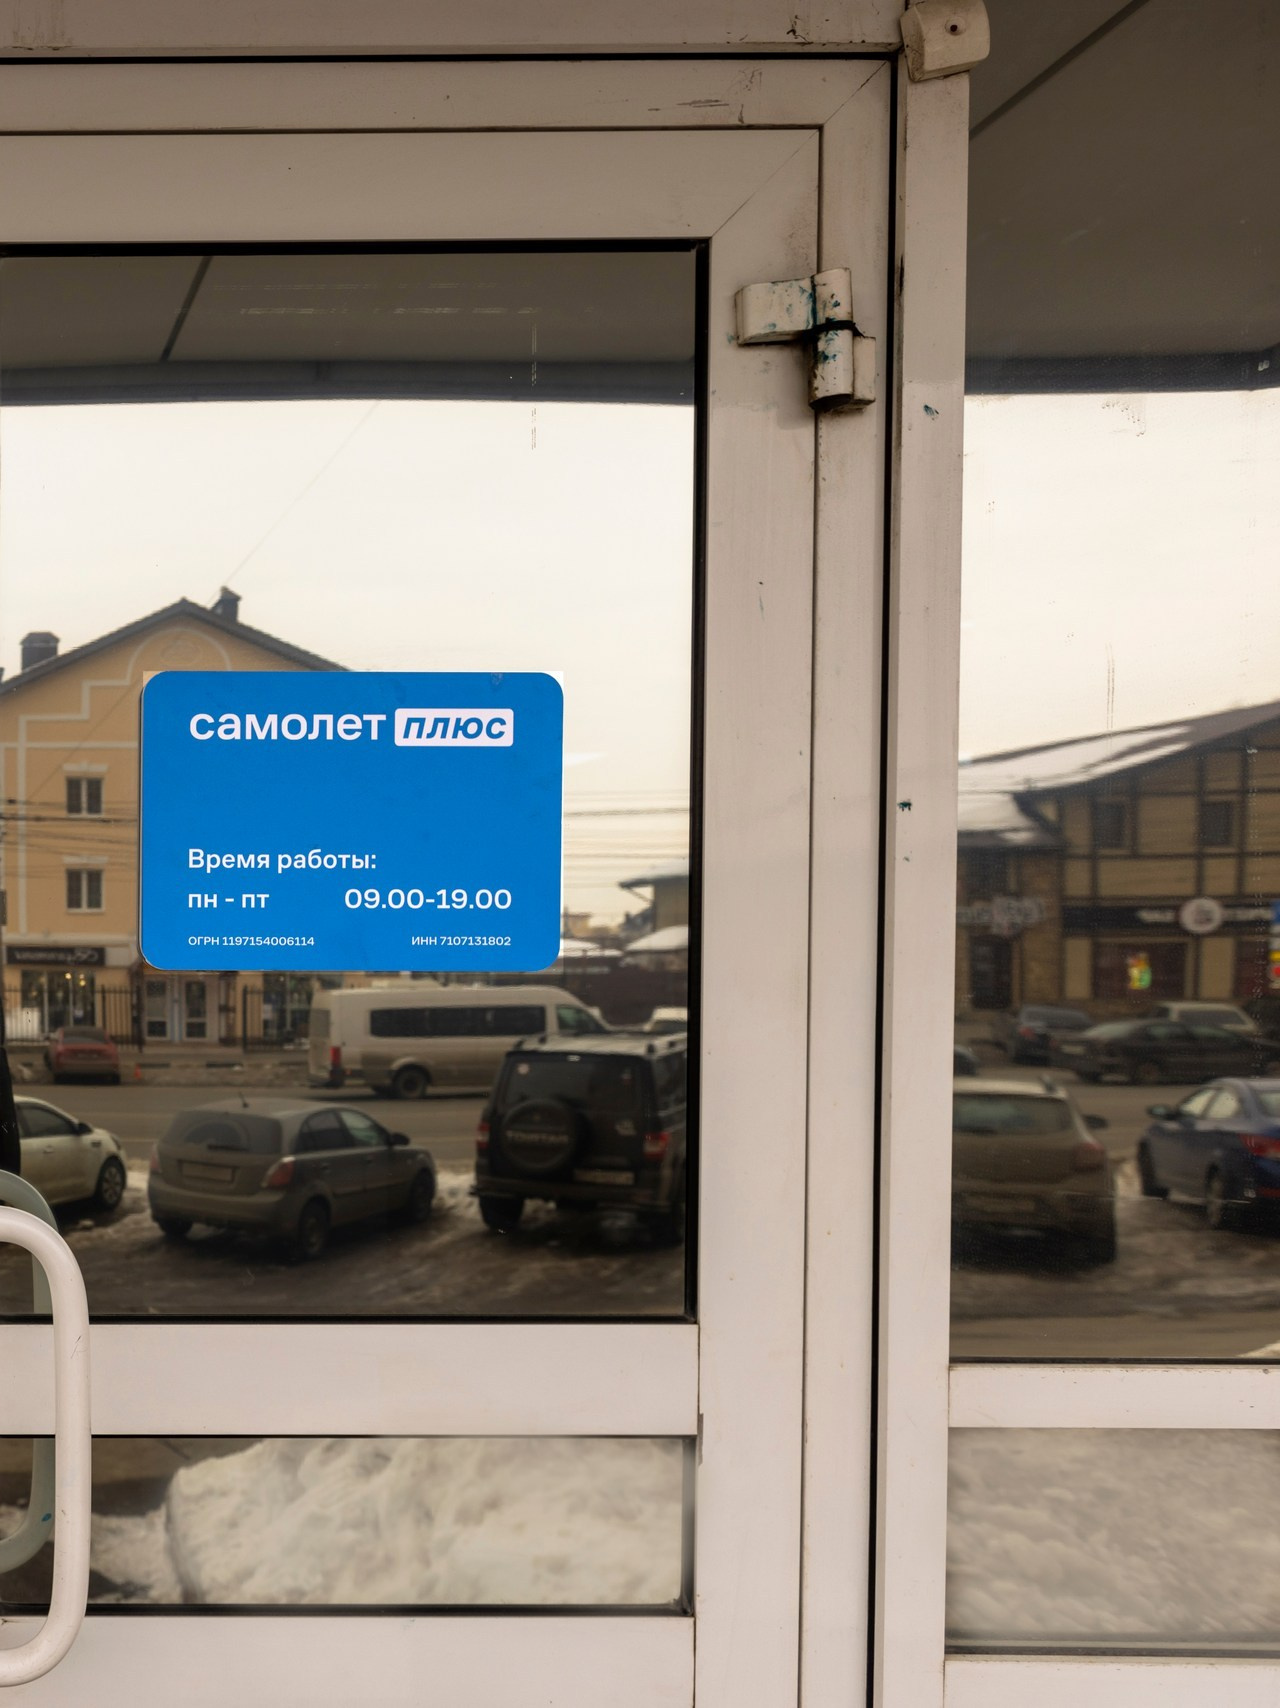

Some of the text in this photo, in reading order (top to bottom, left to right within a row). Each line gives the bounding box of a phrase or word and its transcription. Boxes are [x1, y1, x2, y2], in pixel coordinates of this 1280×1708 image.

[189, 713, 507, 740] самолет плюс
[188, 848, 377, 874] Время работы:
[188, 893, 218, 909] пн
[241, 893, 270, 909] пт
[344, 888, 512, 910] 09.00-19.00
[188, 936, 315, 946] ОГРН 1197154006114
[411, 936, 512, 946] ИНН 7107131802
